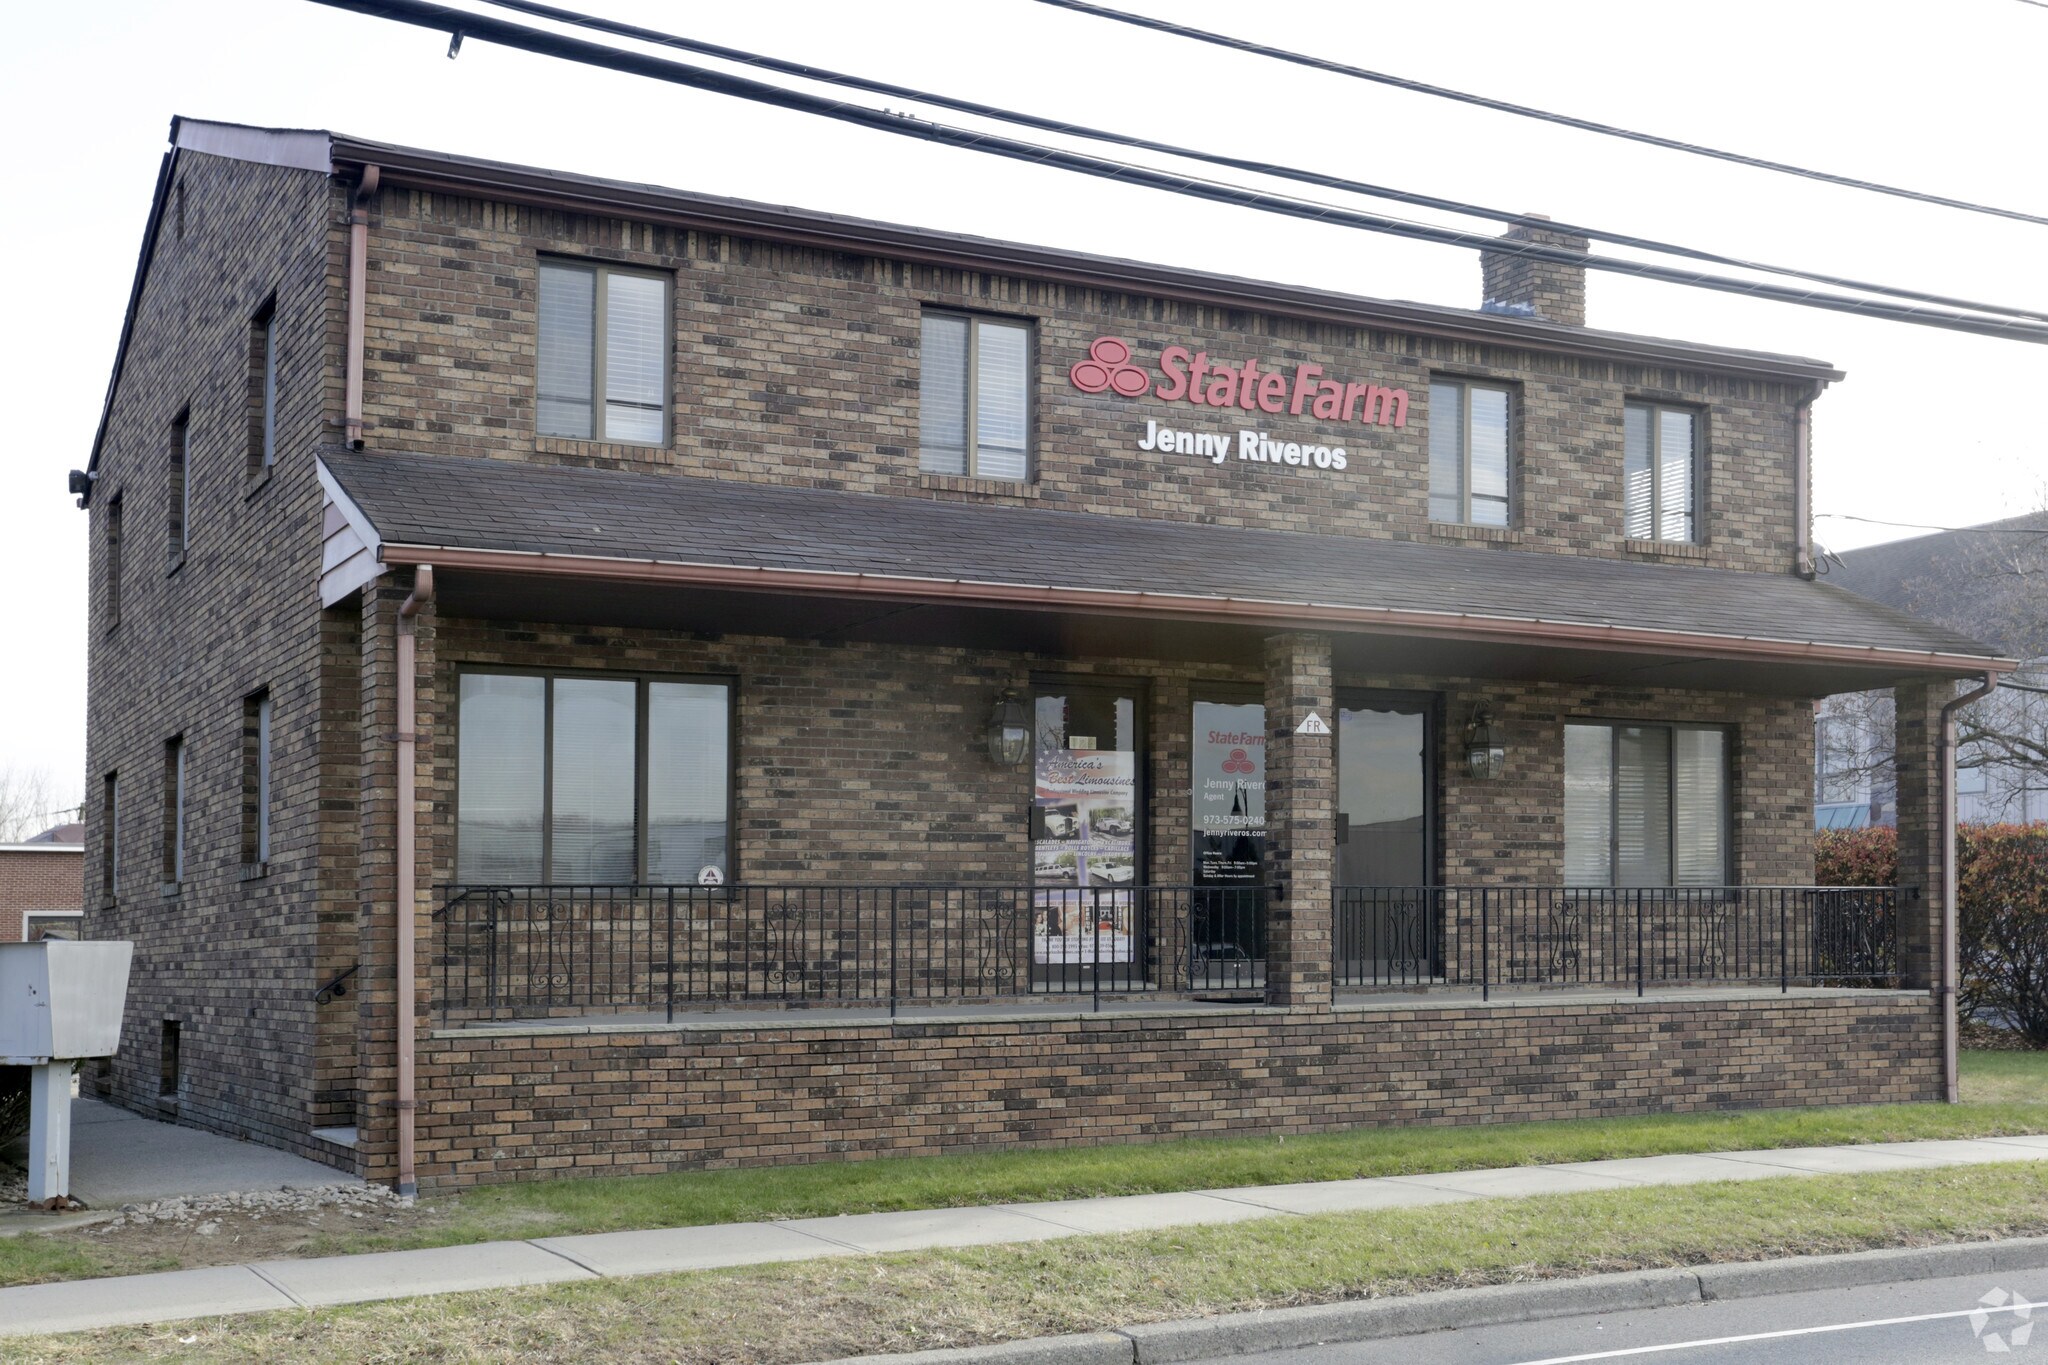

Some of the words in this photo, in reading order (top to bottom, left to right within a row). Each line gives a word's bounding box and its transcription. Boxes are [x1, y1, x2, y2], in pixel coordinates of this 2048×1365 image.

[1138, 420, 1231, 464] Jenny
[1238, 430, 1348, 470] Riveros
[1306, 720, 1321, 732] FR
[1047, 756, 1104, 769] America's
[1048, 770, 1075, 784] Best
[1075, 773, 1136, 786] Limousines
[1203, 778, 1234, 791] Jenny
[1203, 792, 1225, 801] Agent
[1203, 815, 1265, 825] 973-575-0240
